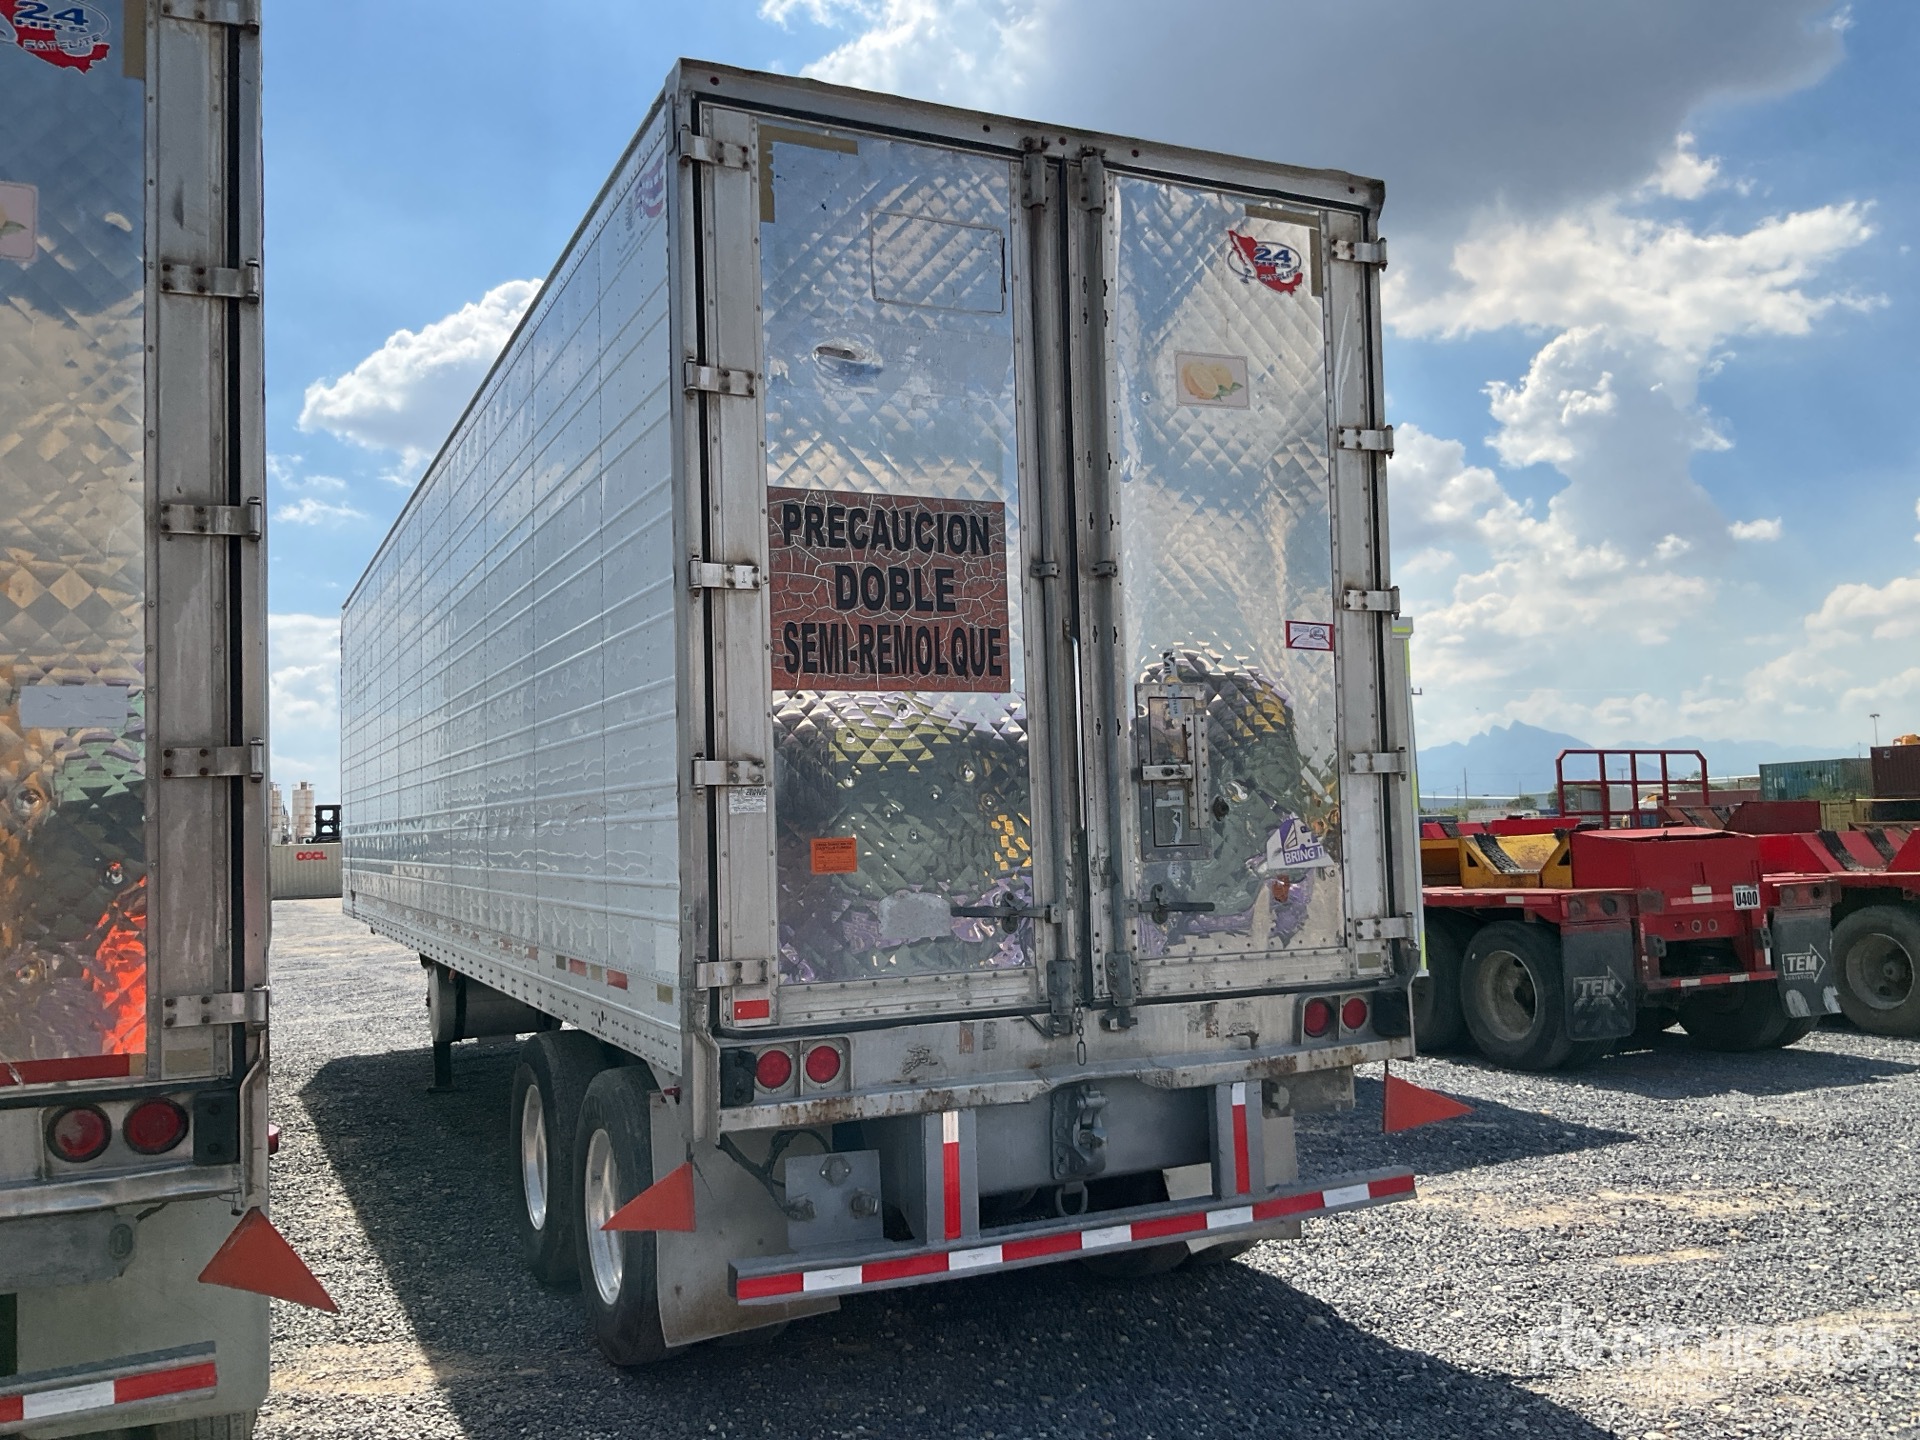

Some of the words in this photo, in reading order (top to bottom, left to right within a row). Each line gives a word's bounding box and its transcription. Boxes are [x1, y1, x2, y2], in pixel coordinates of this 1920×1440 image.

[15, 1, 89, 25] 24
[1254, 247, 1292, 262] 24
[782, 503, 991, 555] PRECAUCION
[834, 564, 957, 612] DOBLE
[783, 621, 1003, 681] SEMI-REMOLQUE
[296, 851, 327, 861] OOCL
[1284, 848, 1315, 864] BRING
[1735, 890, 1758, 907] U400
[1787, 955, 1817, 972] TEM
[1578, 979, 1615, 997] TEM
